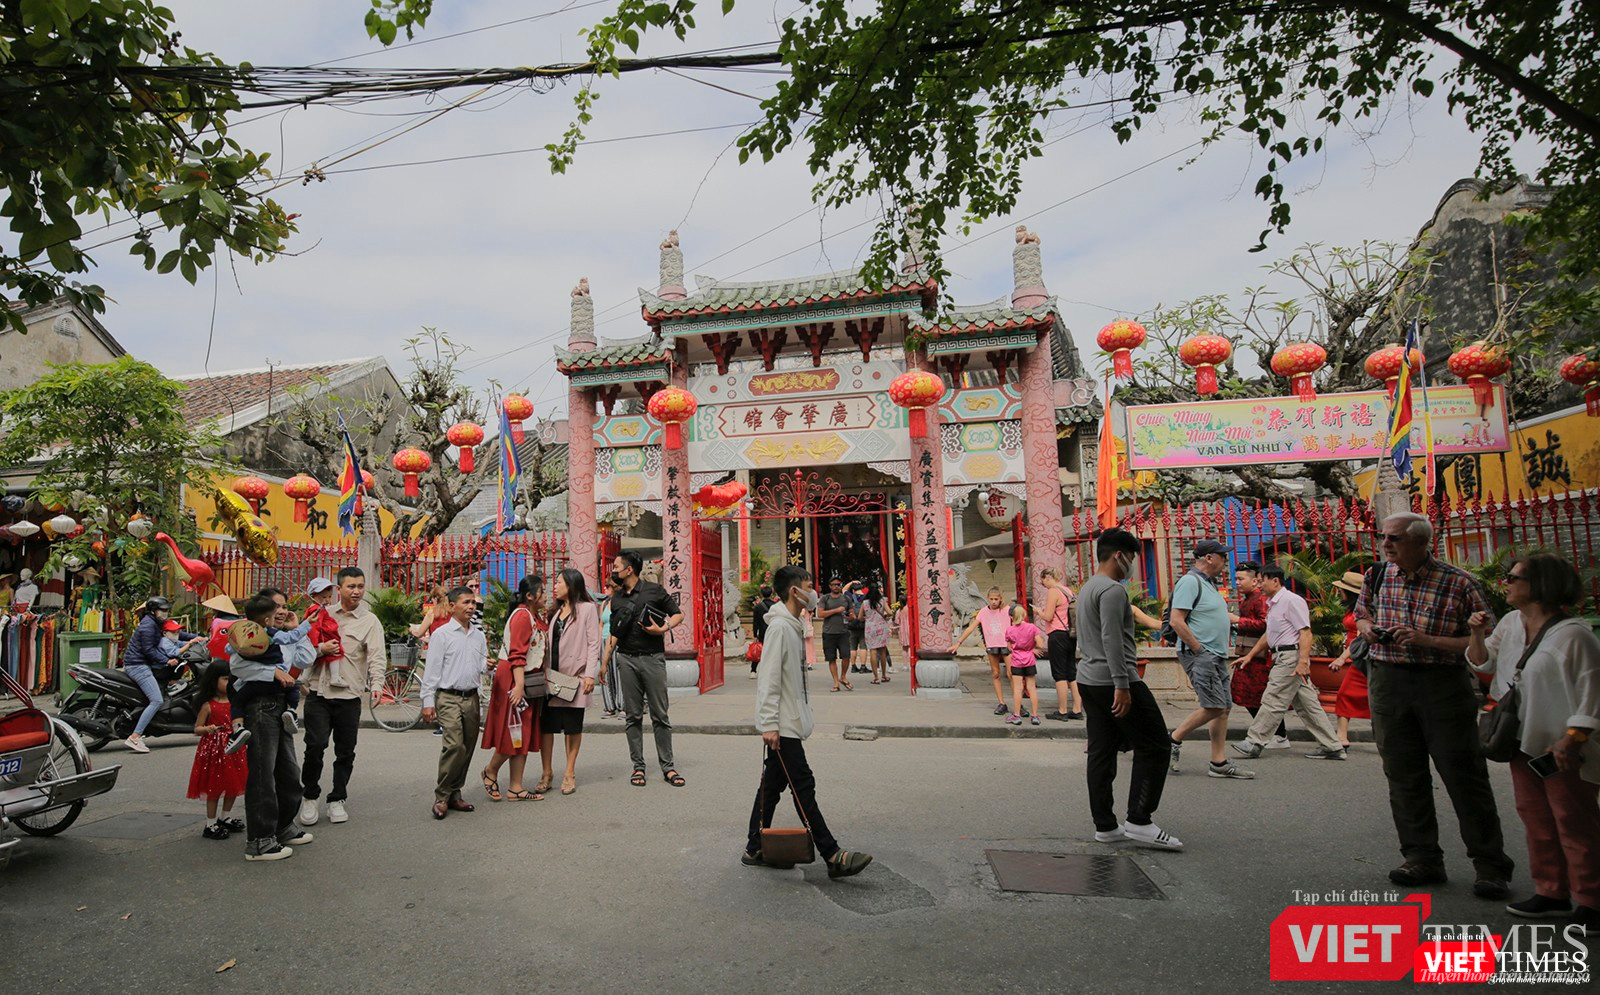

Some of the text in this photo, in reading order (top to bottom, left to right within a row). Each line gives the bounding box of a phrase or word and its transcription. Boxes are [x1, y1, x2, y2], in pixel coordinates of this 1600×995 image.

[743, 401, 848, 431] 廣肇會館
[1136, 412, 1166, 426] Chúc
[1267, 403, 1376, 431] 恭賀新禧
[1197, 446, 1224, 458] VẠN
[1229, 444, 1247, 456] SỰ
[1251, 441, 1281, 453] NHƯ
